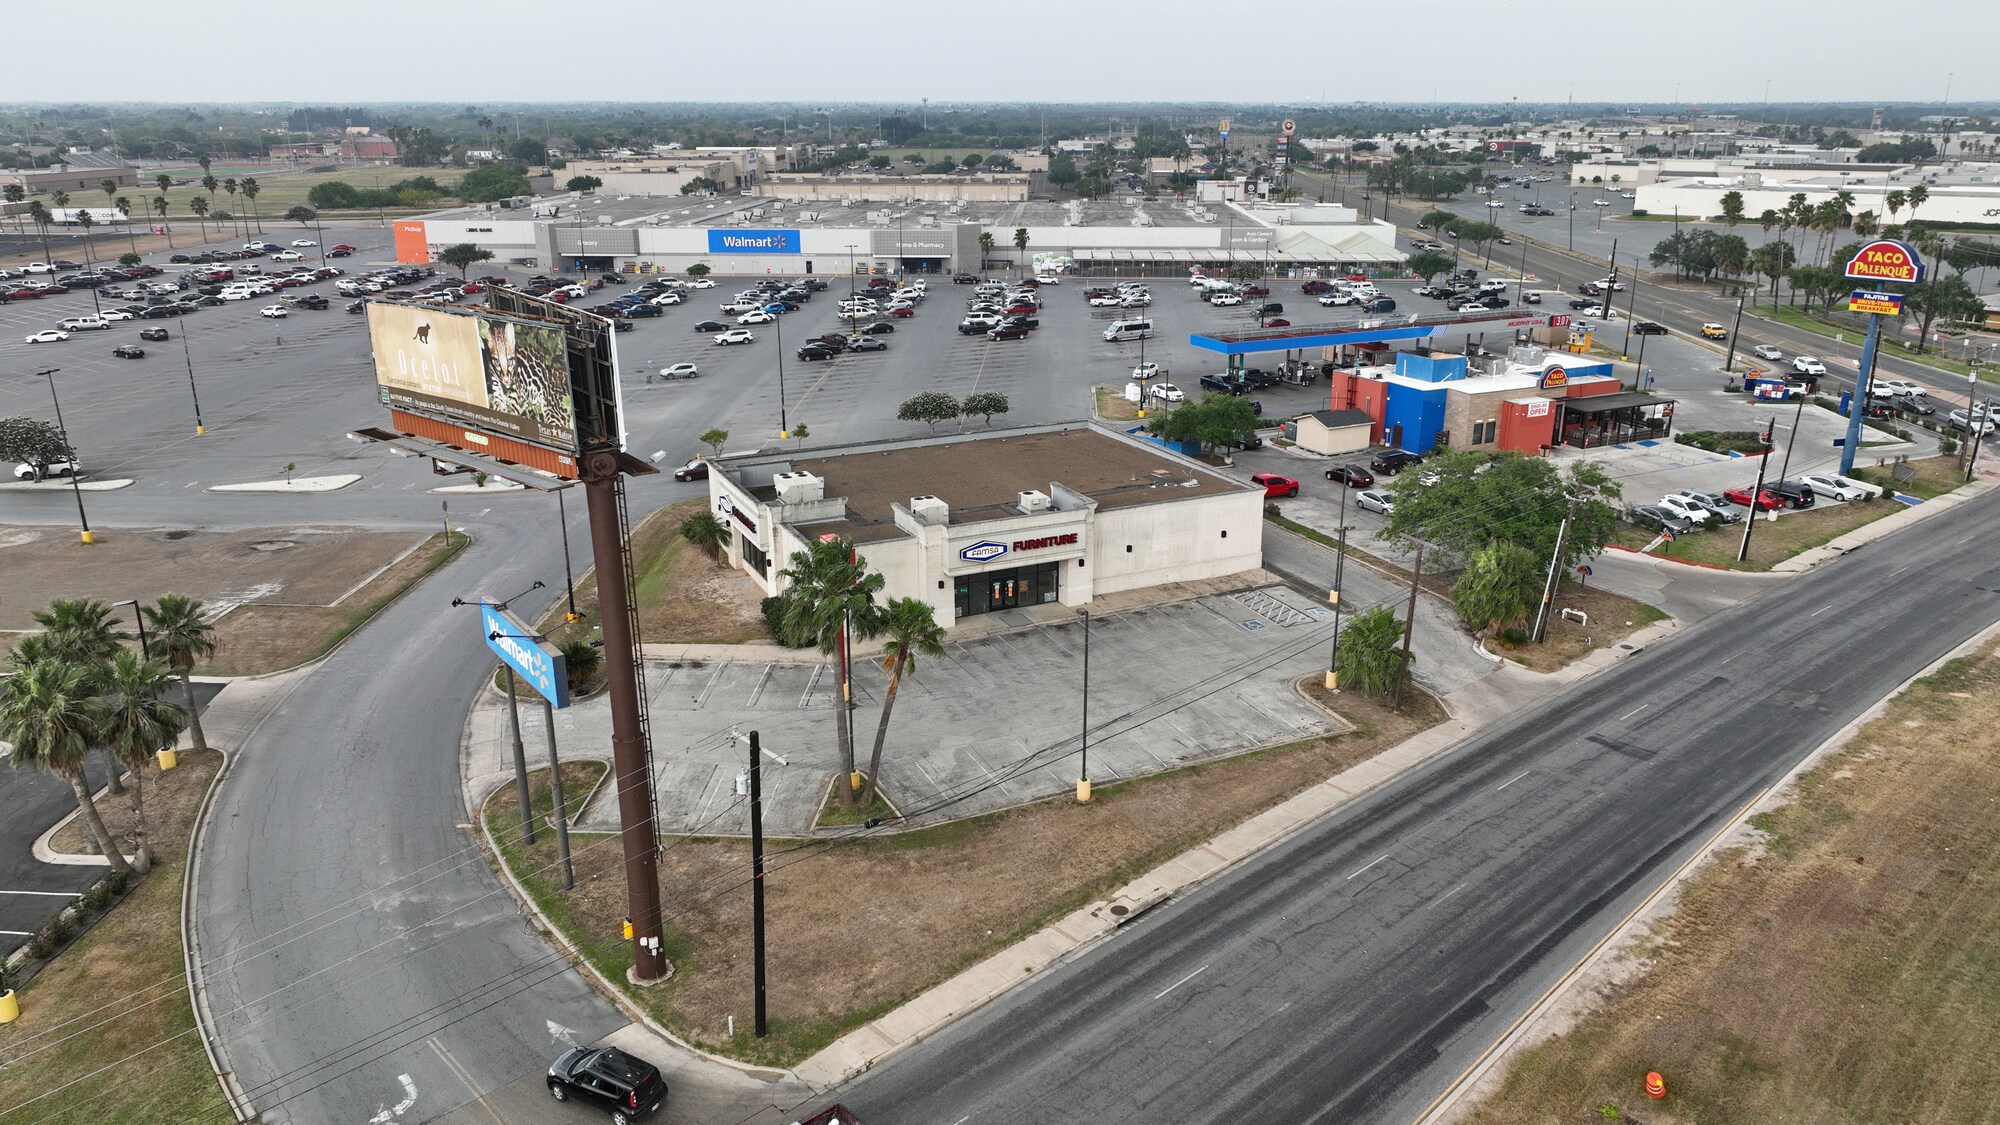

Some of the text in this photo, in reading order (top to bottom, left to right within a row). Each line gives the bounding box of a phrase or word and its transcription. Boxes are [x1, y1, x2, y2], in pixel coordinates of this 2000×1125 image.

[723, 236, 772, 247] Walmart
[1866, 251, 1904, 265] TACO
[1853, 261, 1911, 278] PALENQUE
[1863, 293, 1889, 301] FAJITAS
[1857, 299, 1894, 307] DRIVE-THRU
[1856, 305, 1892, 313] BREAKFAST
[1507, 319, 1531, 327] MURPHY
[398, 349, 461, 386] Ocelot
[1530, 408, 1547, 416] OPEN
[537, 423, 552, 436] Texas
[1013, 533, 1078, 552] FURNITURE
[971, 547, 999, 557] FAMSA
